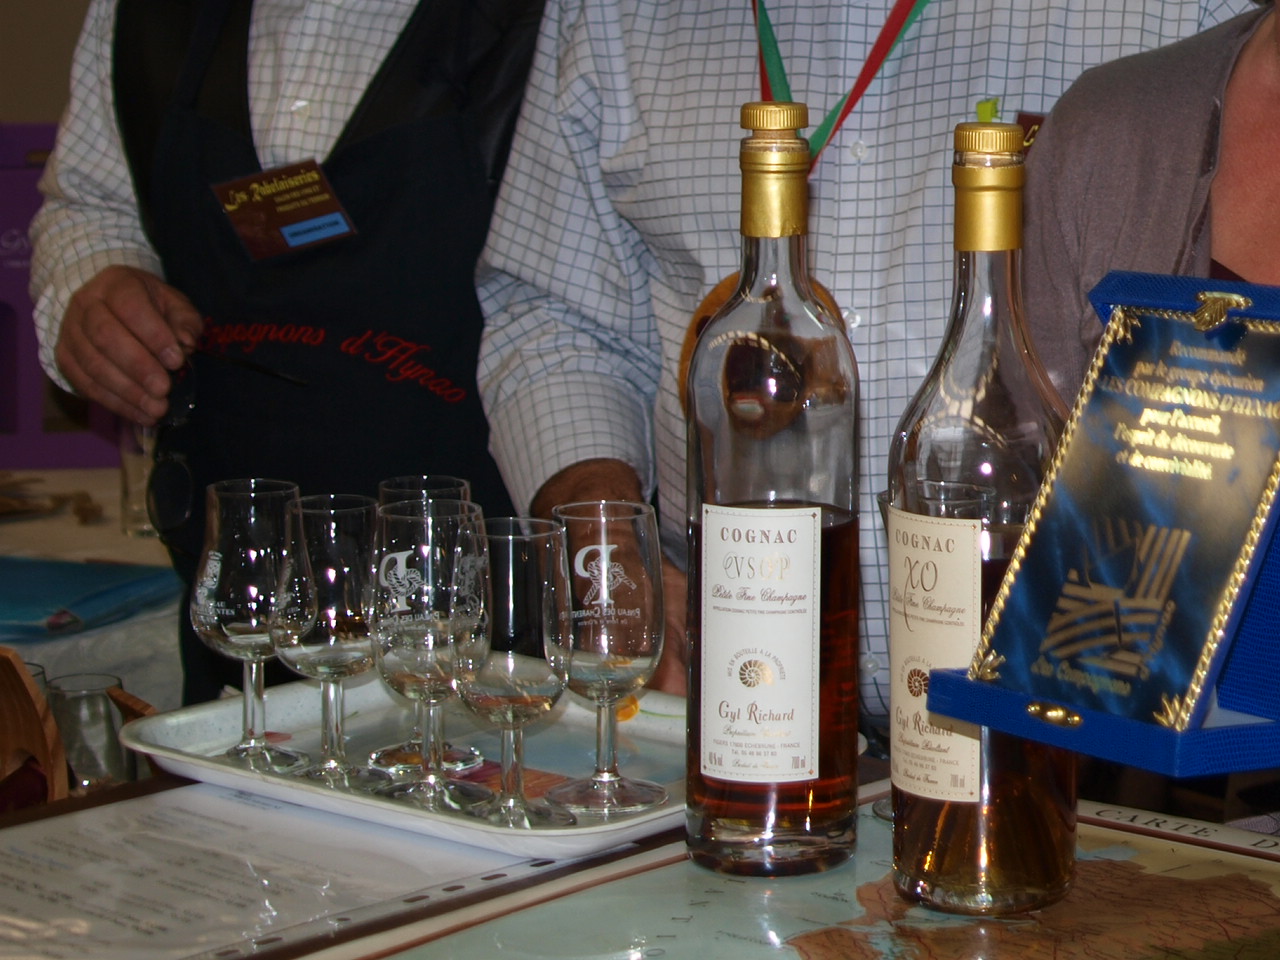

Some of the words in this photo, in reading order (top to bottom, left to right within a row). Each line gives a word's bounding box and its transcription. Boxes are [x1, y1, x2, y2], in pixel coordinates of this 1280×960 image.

[224, 190, 248, 211] Les
[249, 169, 319, 202] Rabelaiseries
[721, 527, 797, 543] COGNAC
[896, 529, 955, 553] COGNAC
[760, 588, 807, 606] Champagne
[904, 556, 938, 632] XO
[922, 596, 966, 618] Champagne
[719, 700, 740, 723] Gyl
[747, 701, 794, 725] Richard
[896, 706, 909, 730] Gyl
[912, 711, 953, 737] Richard
[1095, 807, 1220, 838] CARTE
